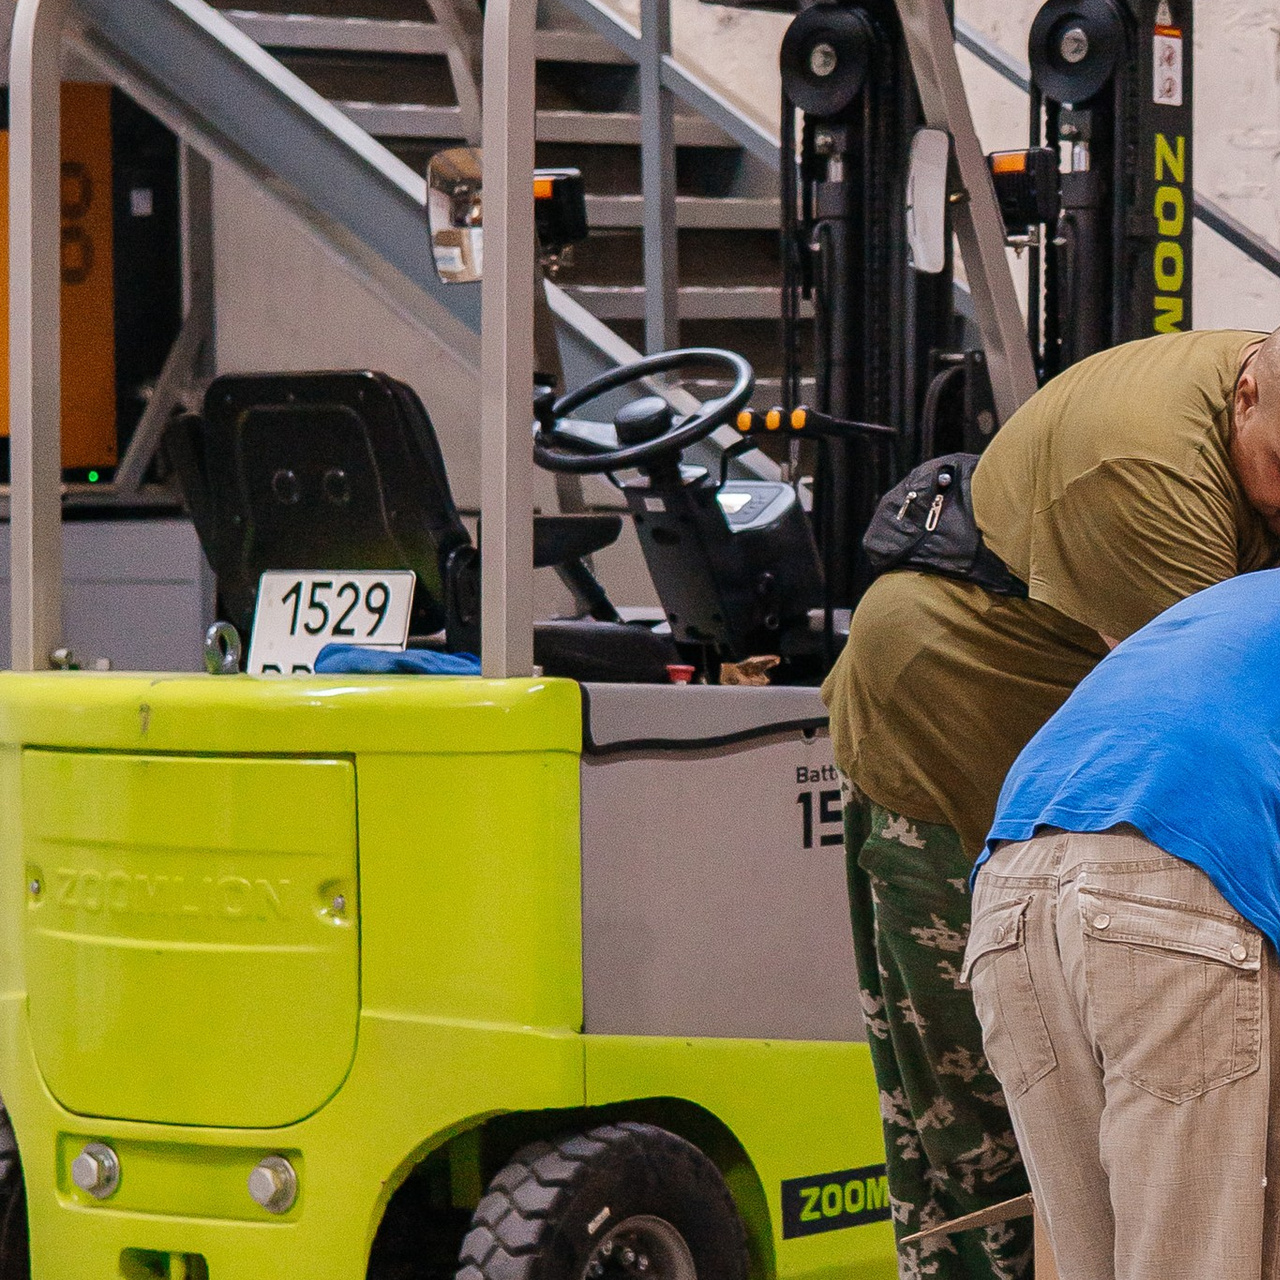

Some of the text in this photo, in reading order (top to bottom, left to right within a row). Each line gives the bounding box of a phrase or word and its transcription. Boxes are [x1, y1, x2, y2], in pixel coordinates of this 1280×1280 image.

[282, 580, 390, 637] 1529
[56, 867, 292, 923] ZOOMLION
[799, 1175, 890, 1222] ZOOM
